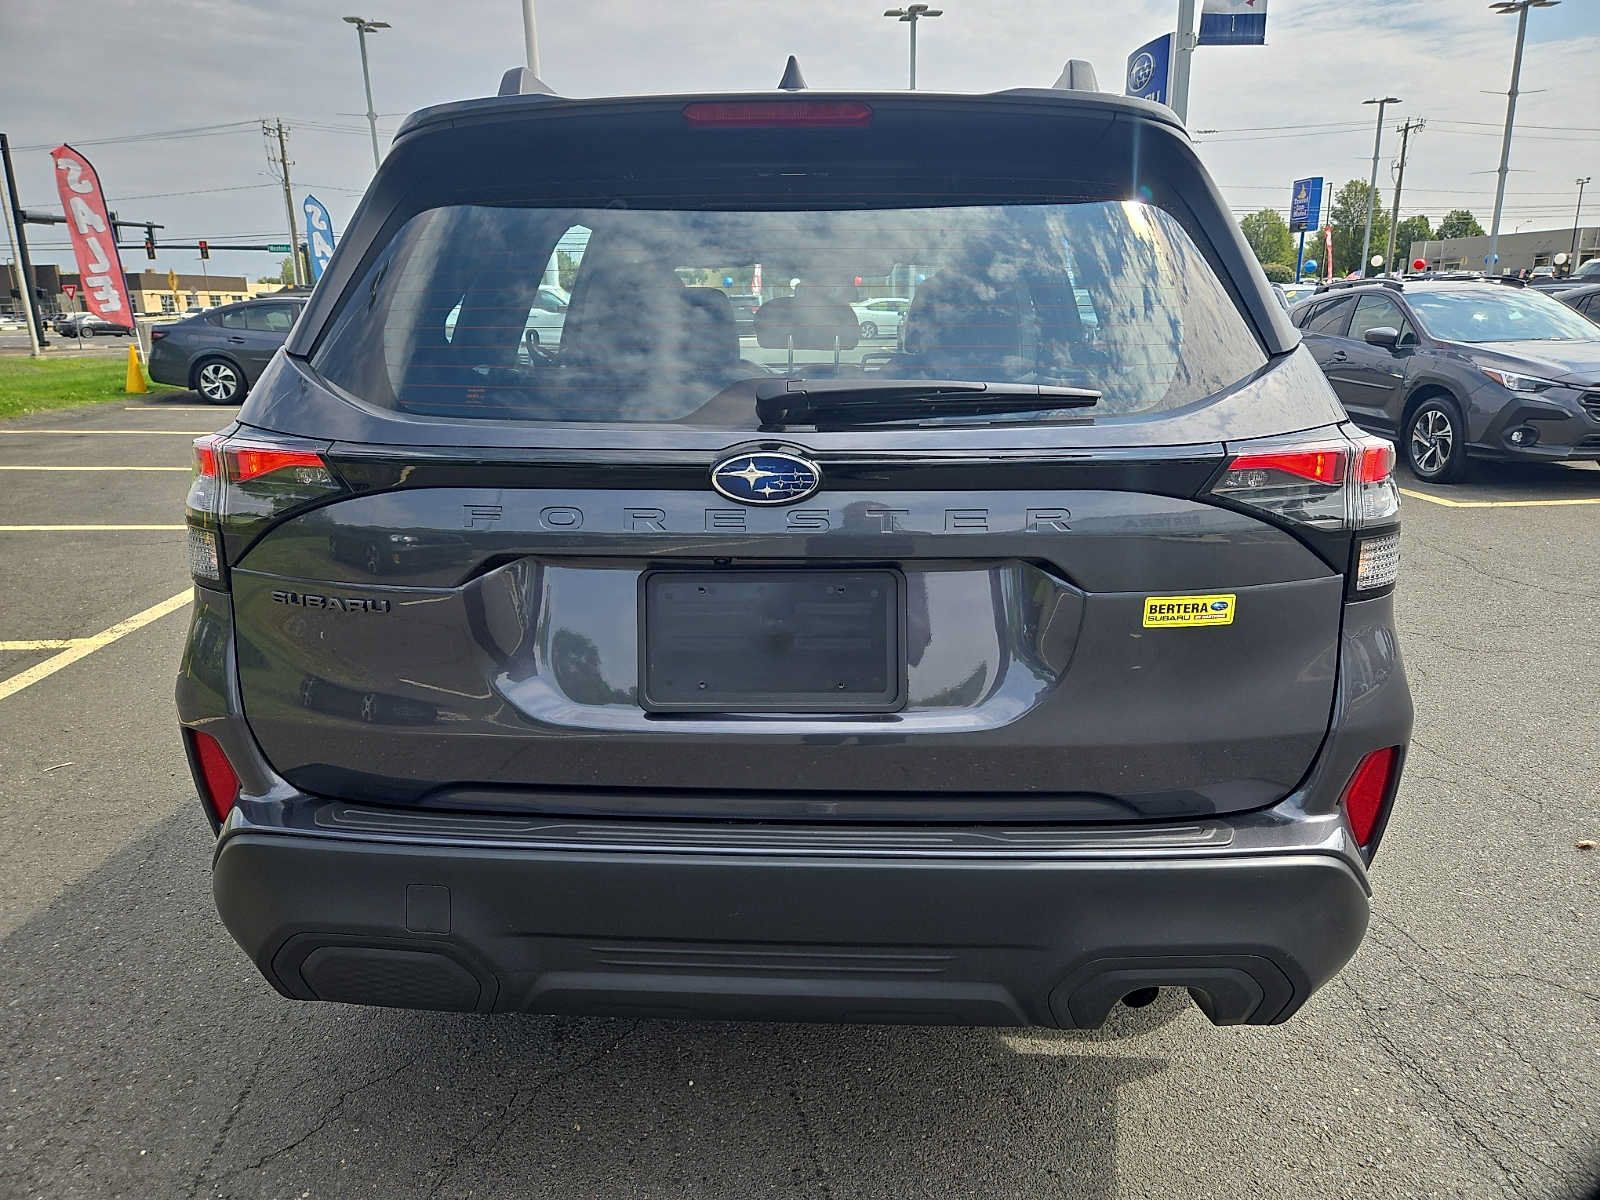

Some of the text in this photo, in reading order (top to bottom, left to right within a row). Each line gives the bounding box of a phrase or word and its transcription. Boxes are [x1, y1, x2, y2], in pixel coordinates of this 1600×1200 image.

[463, 504, 1073, 534] FORESTER
[271, 590, 392, 614] SUBARU
[1149, 603, 1208, 614] BERTERA
